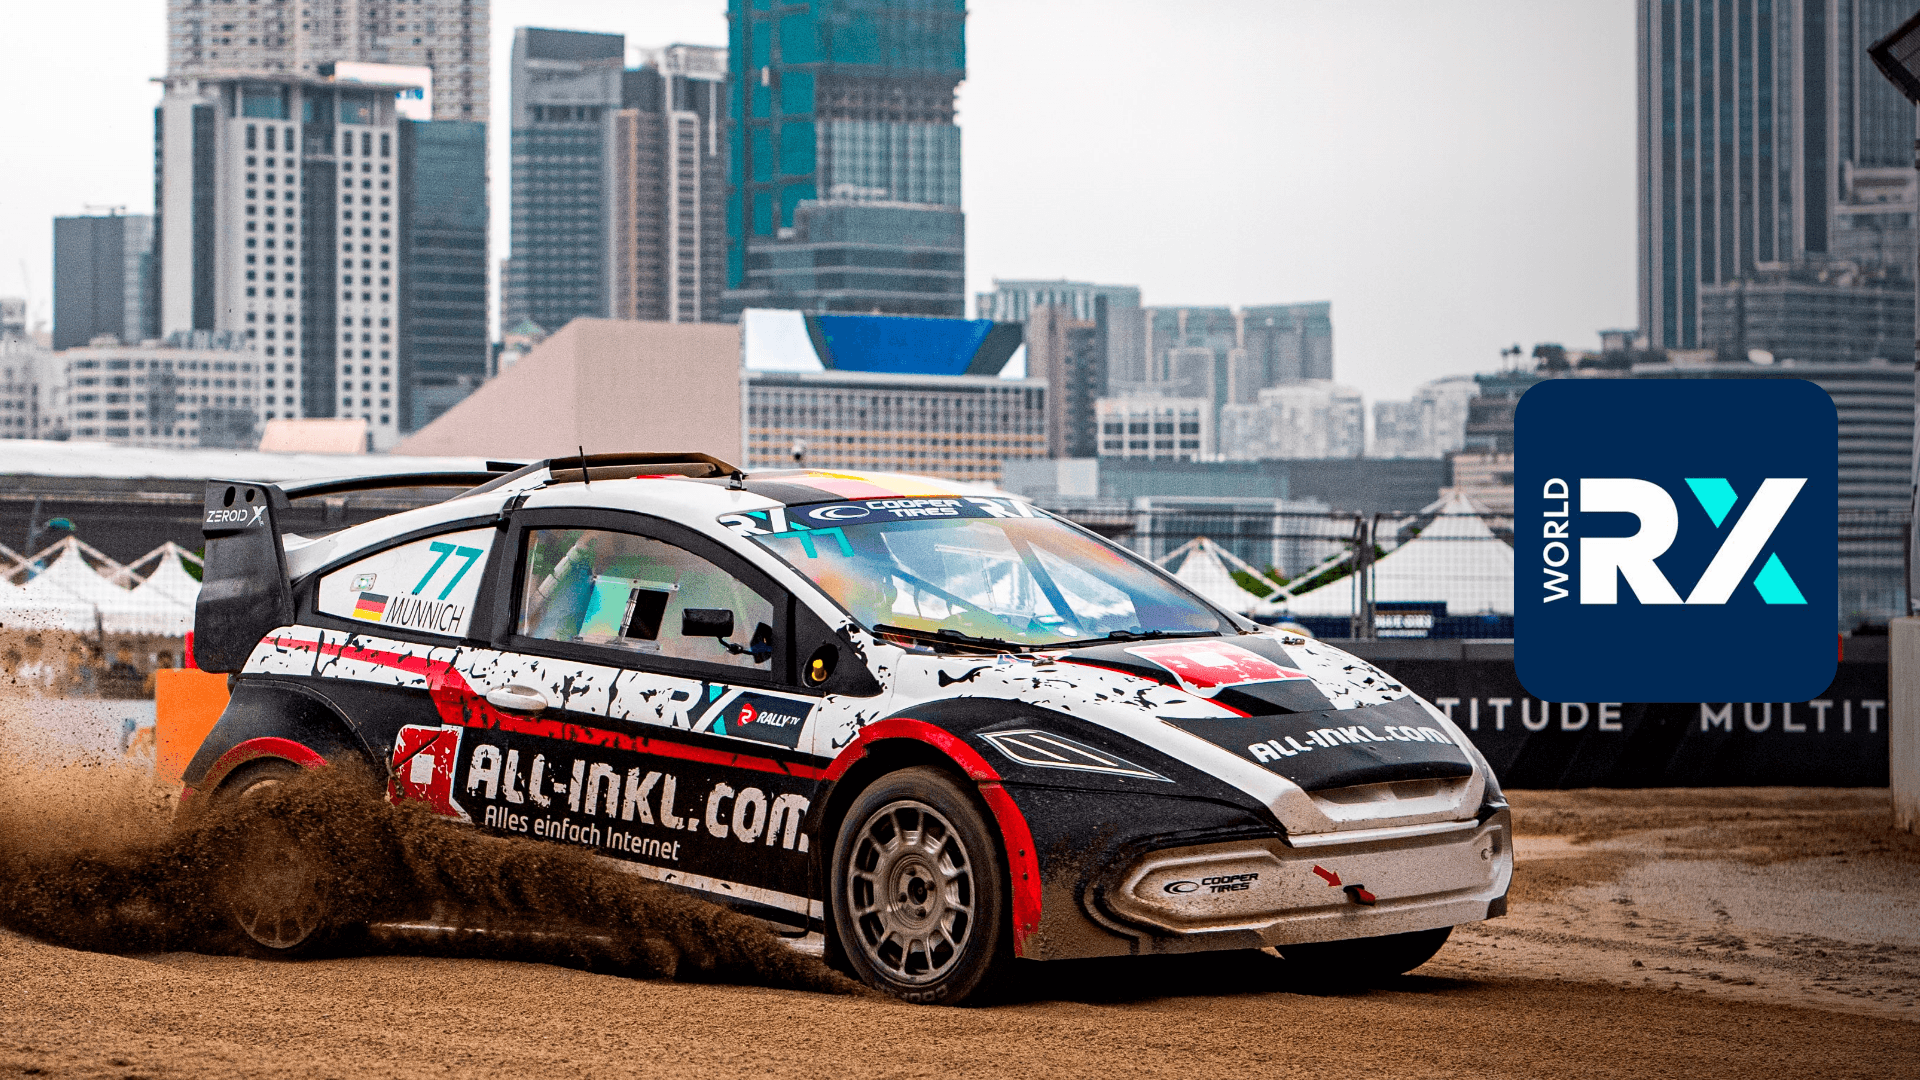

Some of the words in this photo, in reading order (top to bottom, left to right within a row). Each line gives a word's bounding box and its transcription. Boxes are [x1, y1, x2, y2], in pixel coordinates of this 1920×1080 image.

[866, 499, 963, 510] COOPER
[889, 507, 959, 517] TIRES
[773, 526, 855, 559] 77
[411, 541, 485, 601] 77
[484, 805, 528, 834] Alles
[533, 814, 601, 847] einfach
[606, 827, 681, 862] Internet
[1201, 873, 1259, 886] COOPER
[1209, 882, 1250, 894] TIRES
